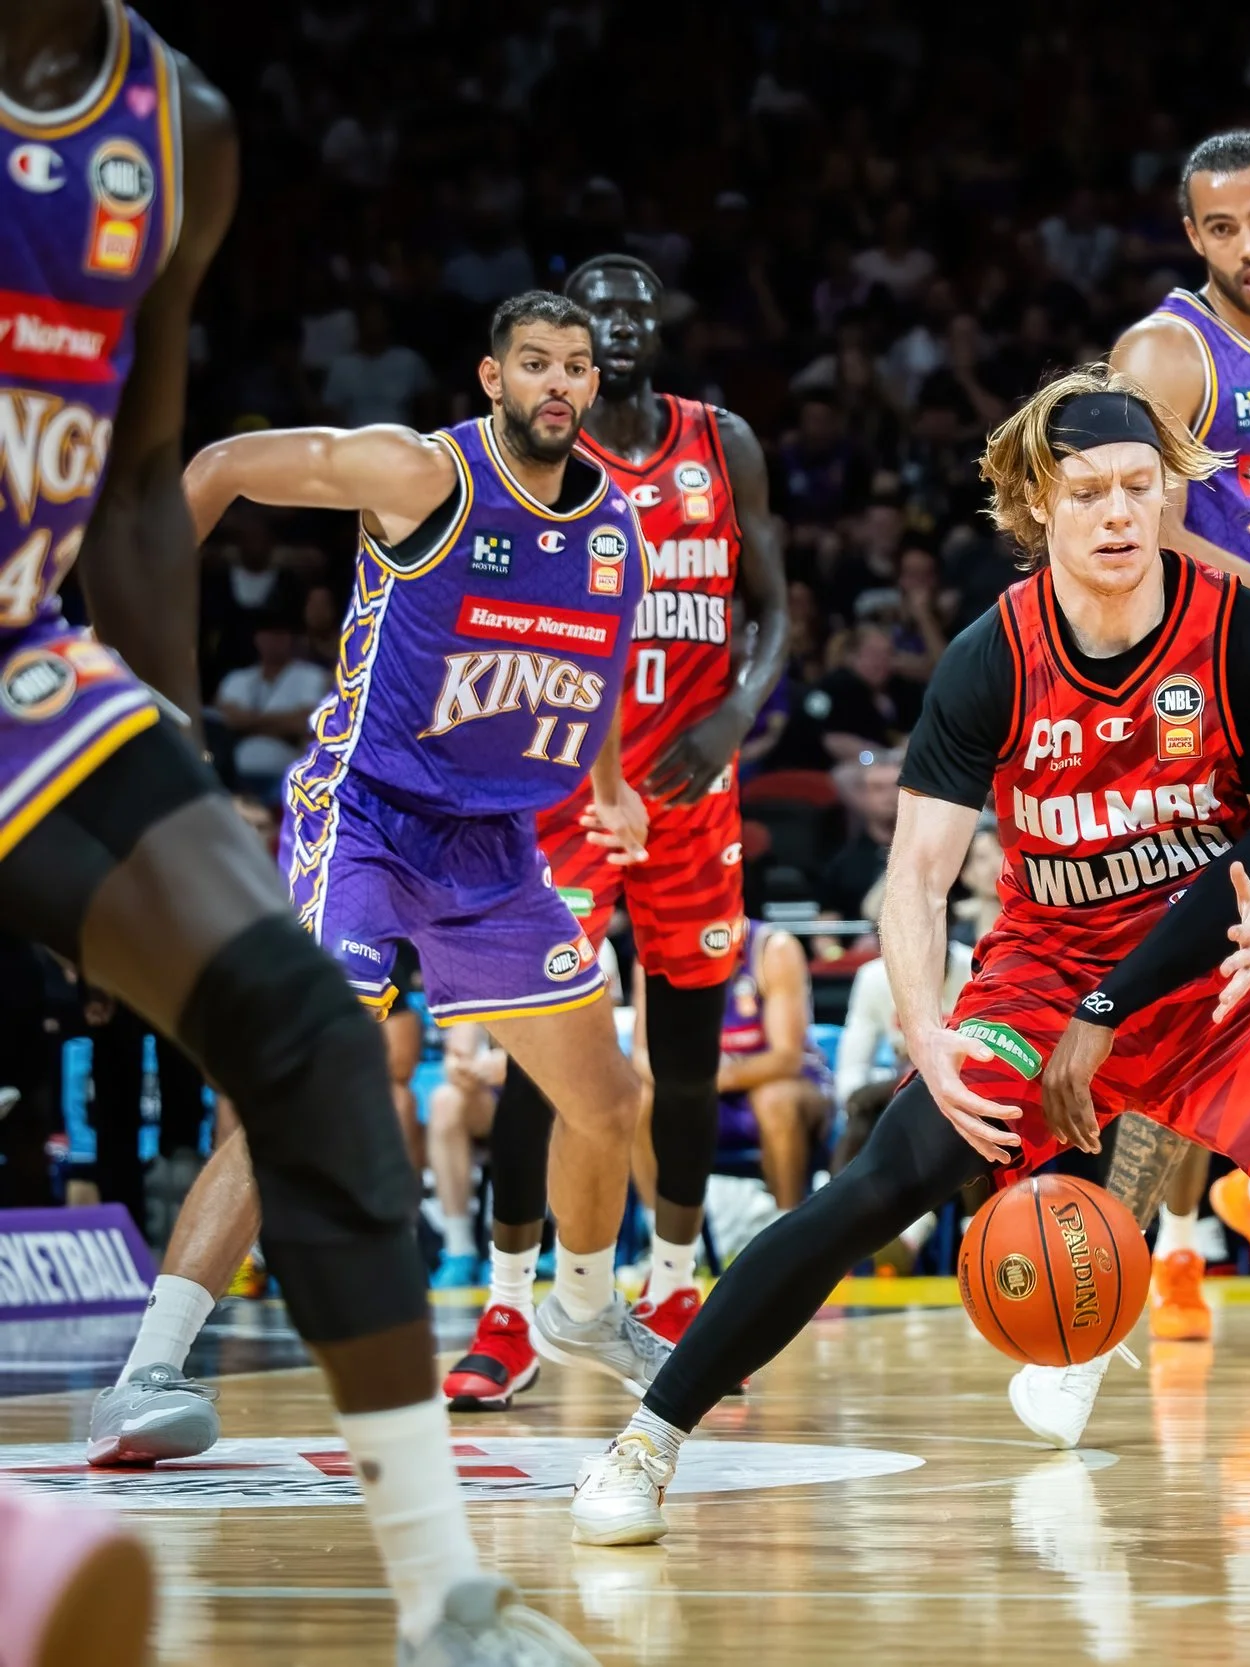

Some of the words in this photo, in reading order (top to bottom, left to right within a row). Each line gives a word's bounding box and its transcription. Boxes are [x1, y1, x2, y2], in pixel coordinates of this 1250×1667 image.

[596, 536, 620, 555] NBL
[472, 561, 509, 574] HOSTPLUS
[470, 607, 535, 634] Harvey
[535, 615, 606, 643] Norman
[633, 592, 726, 645] DCATS
[636, 648, 666, 704] 0
[417, 650, 606, 739] KINGS
[1164, 690, 1193, 711] NBL
[522, 716, 589, 767] 11
[1168, 741, 1193, 749] JACK'S
[1050, 755, 1082, 772] bank
[710, 930, 729, 950] NBL
[551, 950, 576, 973] NBL
[1005, 1264, 1026, 1291] NBL
[1050, 1201, 1101, 1331] SPALDING
